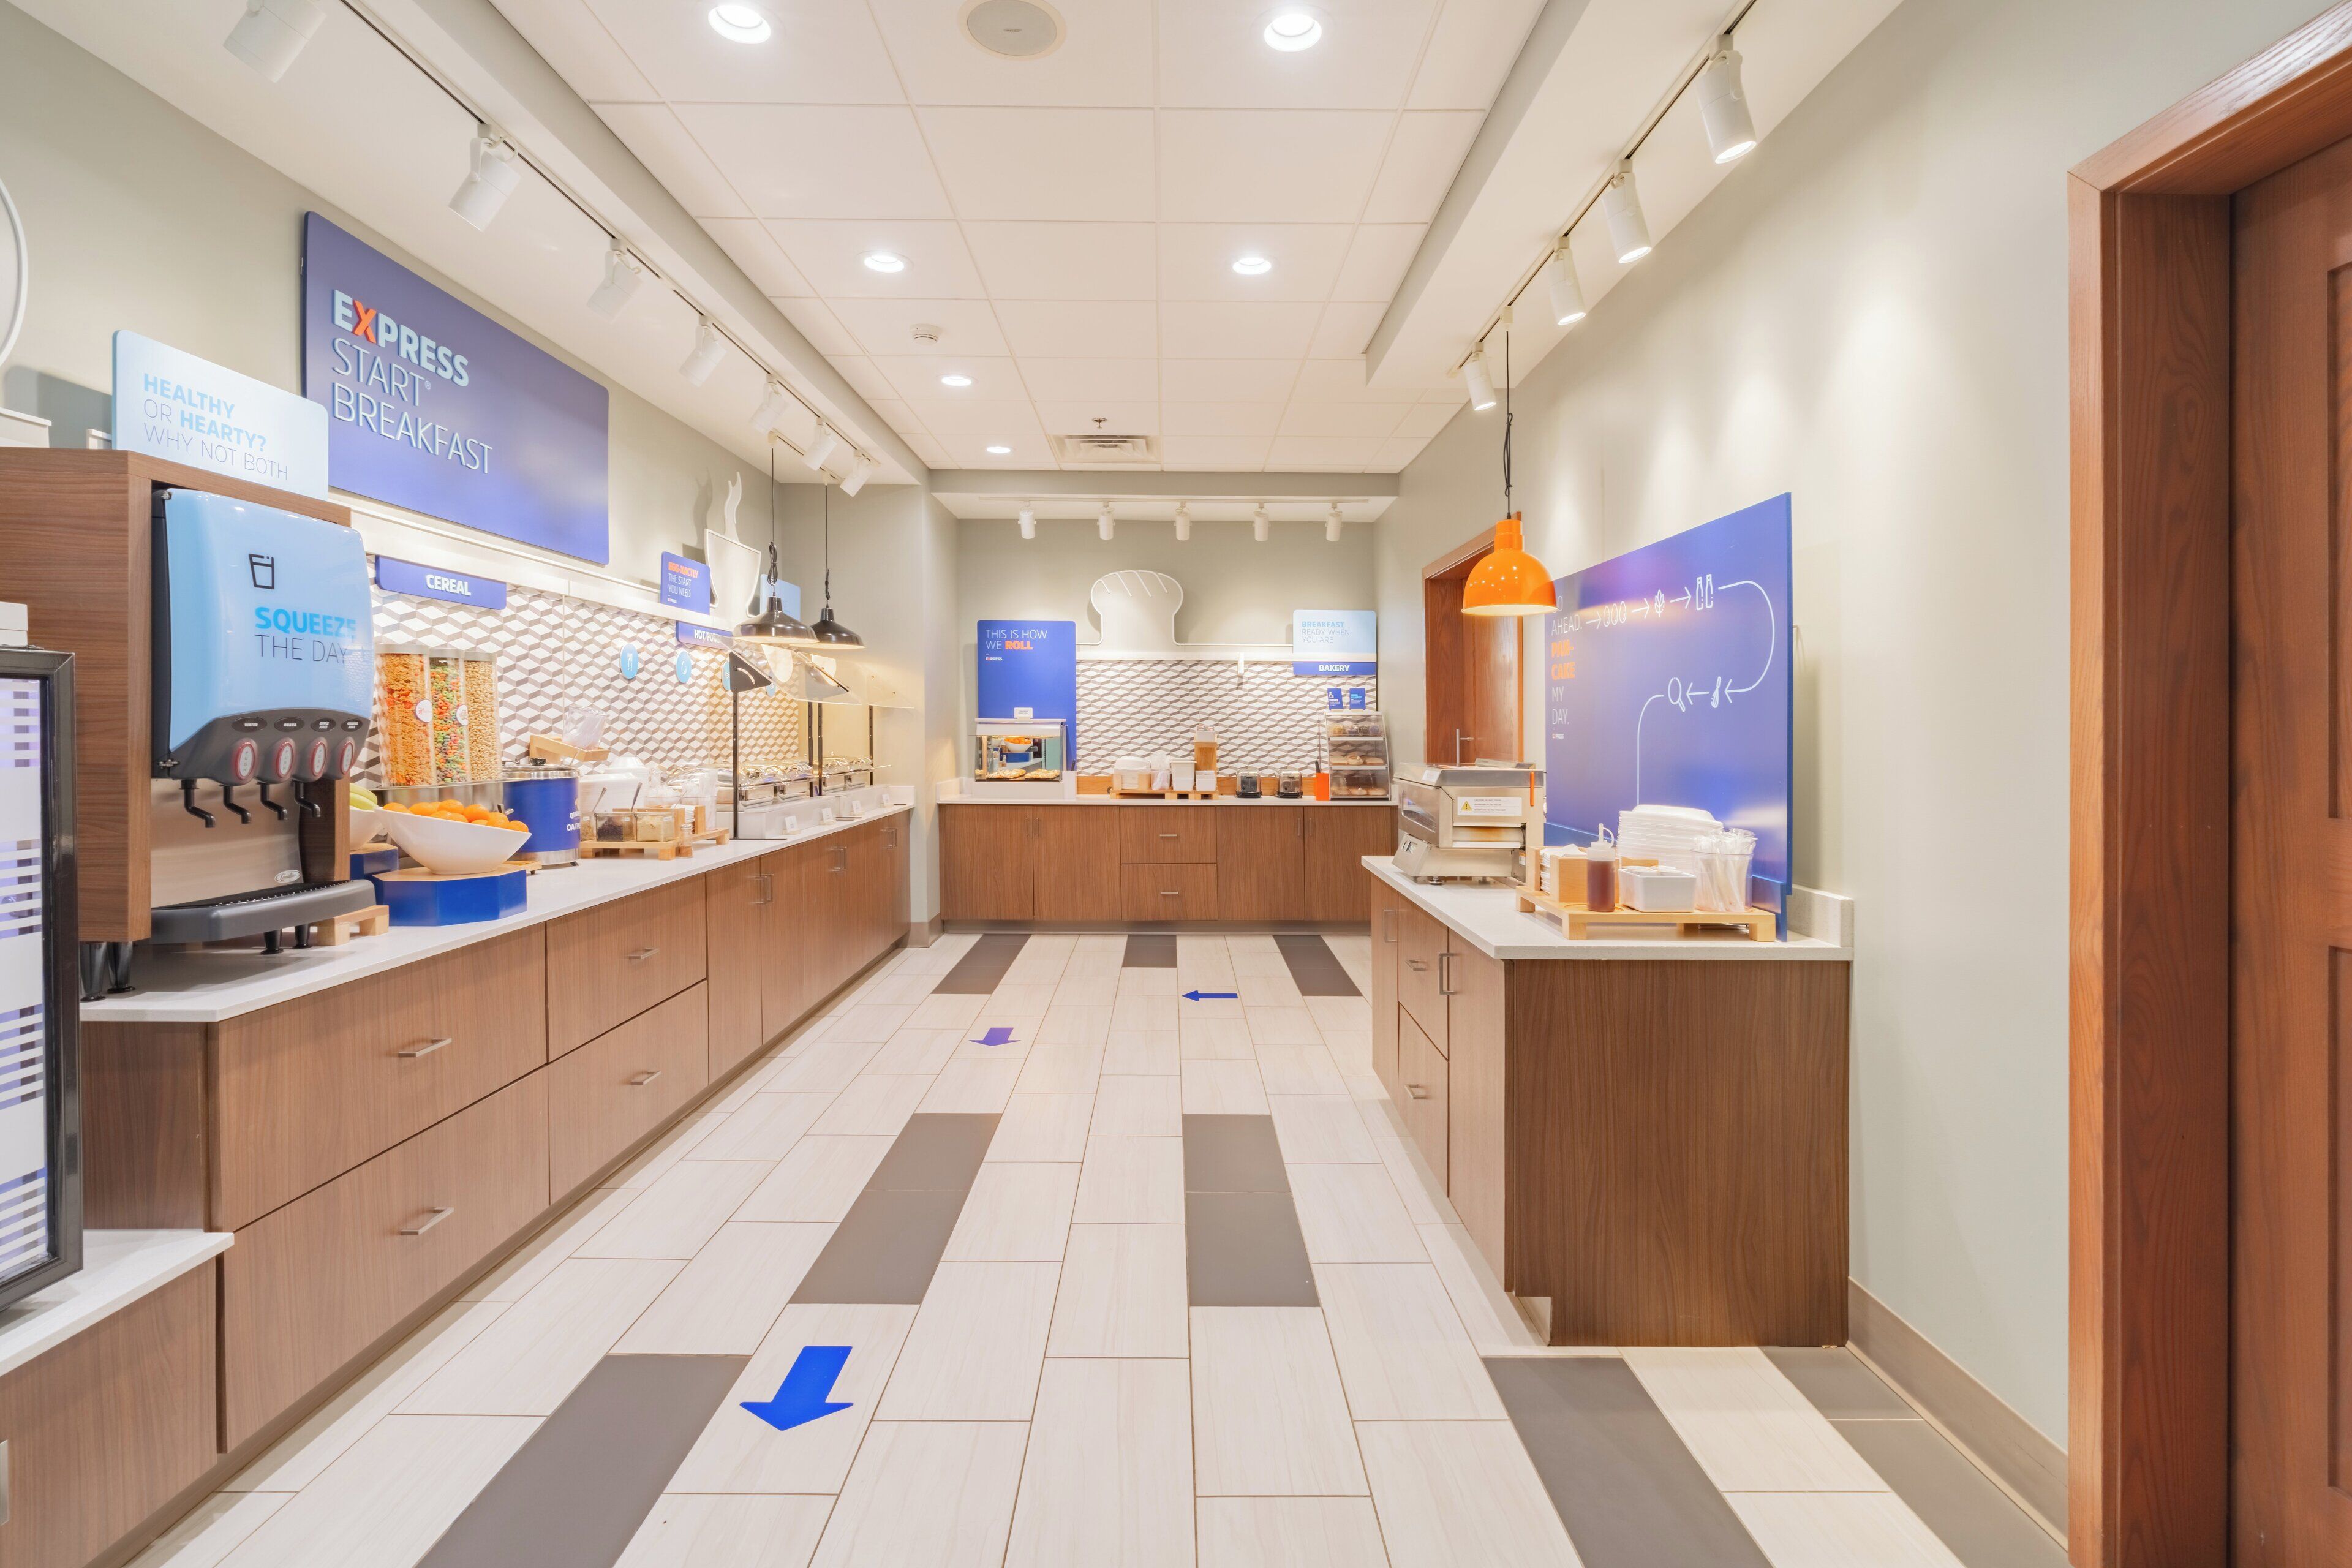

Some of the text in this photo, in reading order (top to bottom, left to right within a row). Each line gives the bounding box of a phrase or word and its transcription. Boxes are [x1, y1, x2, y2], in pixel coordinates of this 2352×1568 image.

[332, 289, 469, 386] EXPRESS
[144, 373, 235, 419] HEALTHY
[144, 399, 266, 452] OR HEARTY?
[332, 382, 492, 474] BREAKFAST
[144, 423, 287, 481] WHY NOT BOTH
[425, 573, 472, 597] CEREAL
[668, 573, 692, 587] THE START
[668, 584, 691, 598] YOU NEED
[255, 606, 356, 639] SQUEEZE
[1551, 614, 1583, 636] AHEAD.
[694, 629, 706, 640] HOT
[986, 629, 1048, 639] THIS IS HOW
[255, 635, 347, 664] THE DAY
[986, 641, 1033, 650] WE ROLL
[1551, 639, 1574, 658] PAN-
[1551, 662, 1575, 680] CAKE
[1552, 686, 1564, 702] MY
[1552, 709, 1569, 725] DAY.
